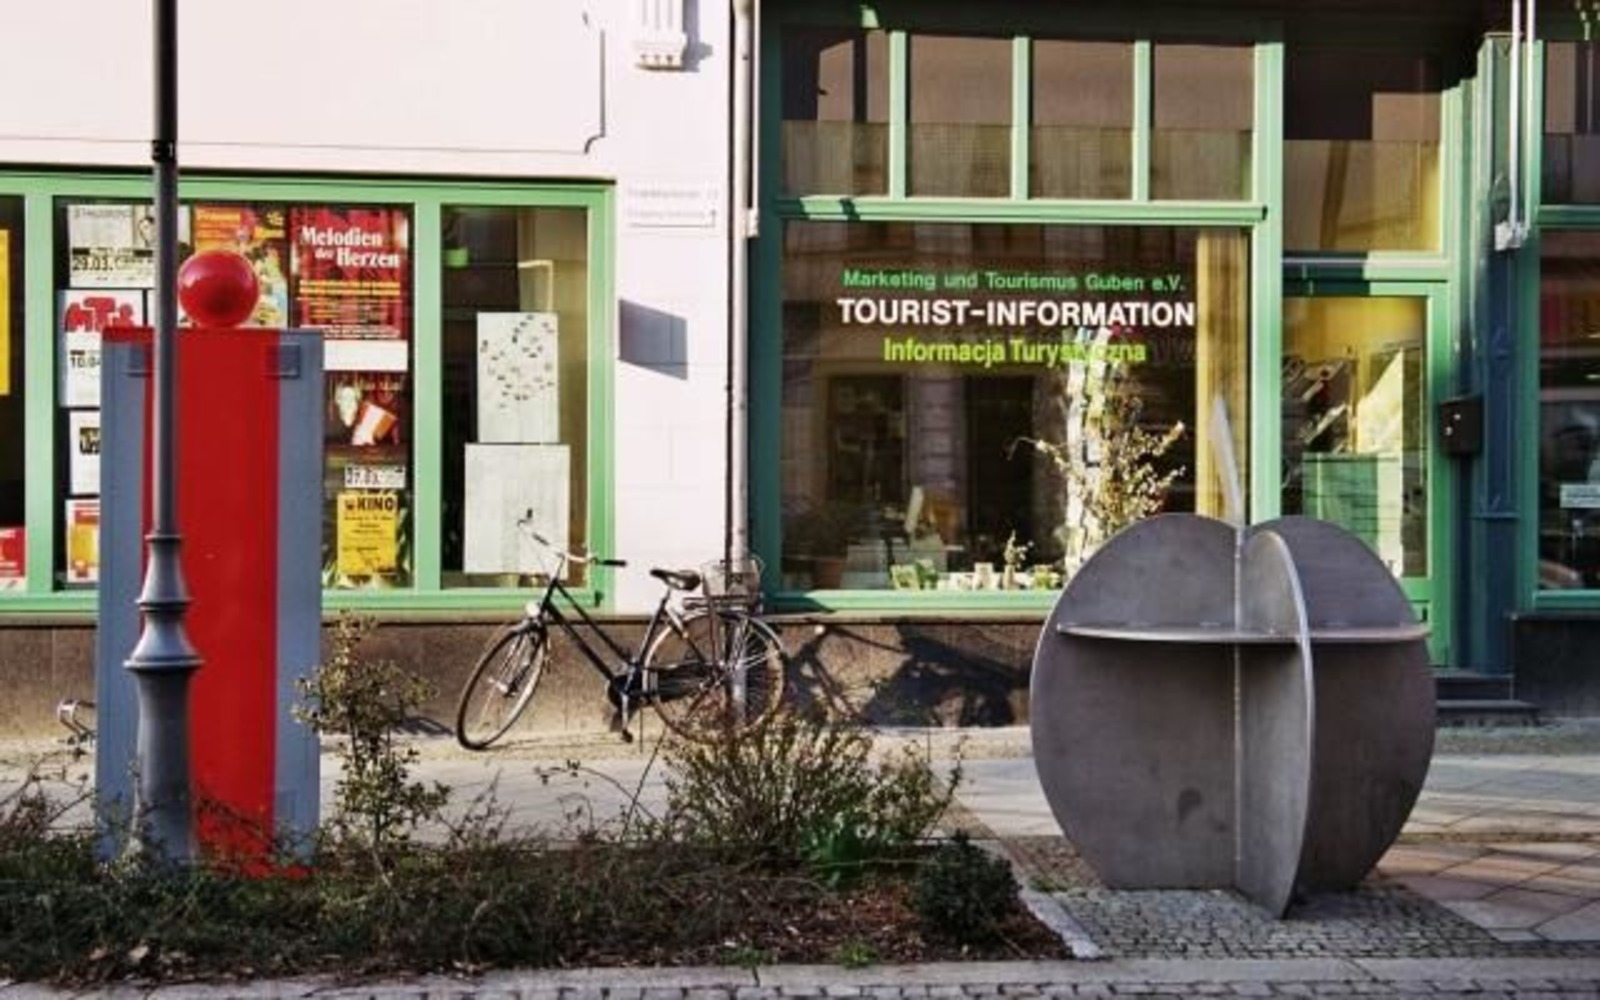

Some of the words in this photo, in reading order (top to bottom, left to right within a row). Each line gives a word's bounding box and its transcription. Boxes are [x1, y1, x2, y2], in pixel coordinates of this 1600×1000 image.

[301, 226, 383, 247] Melodien
[336, 247, 400, 269] Herzen
[842, 270, 937, 291] Marketing
[943, 271, 978, 289] und
[984, 271, 1079, 290] Tourismus
[1084, 273, 1144, 291] Guben
[836, 297, 1196, 327] TOURIST-INFORMATION
[883, 336, 1007, 369] Informacja
[356, 496, 396, 511] KINO
